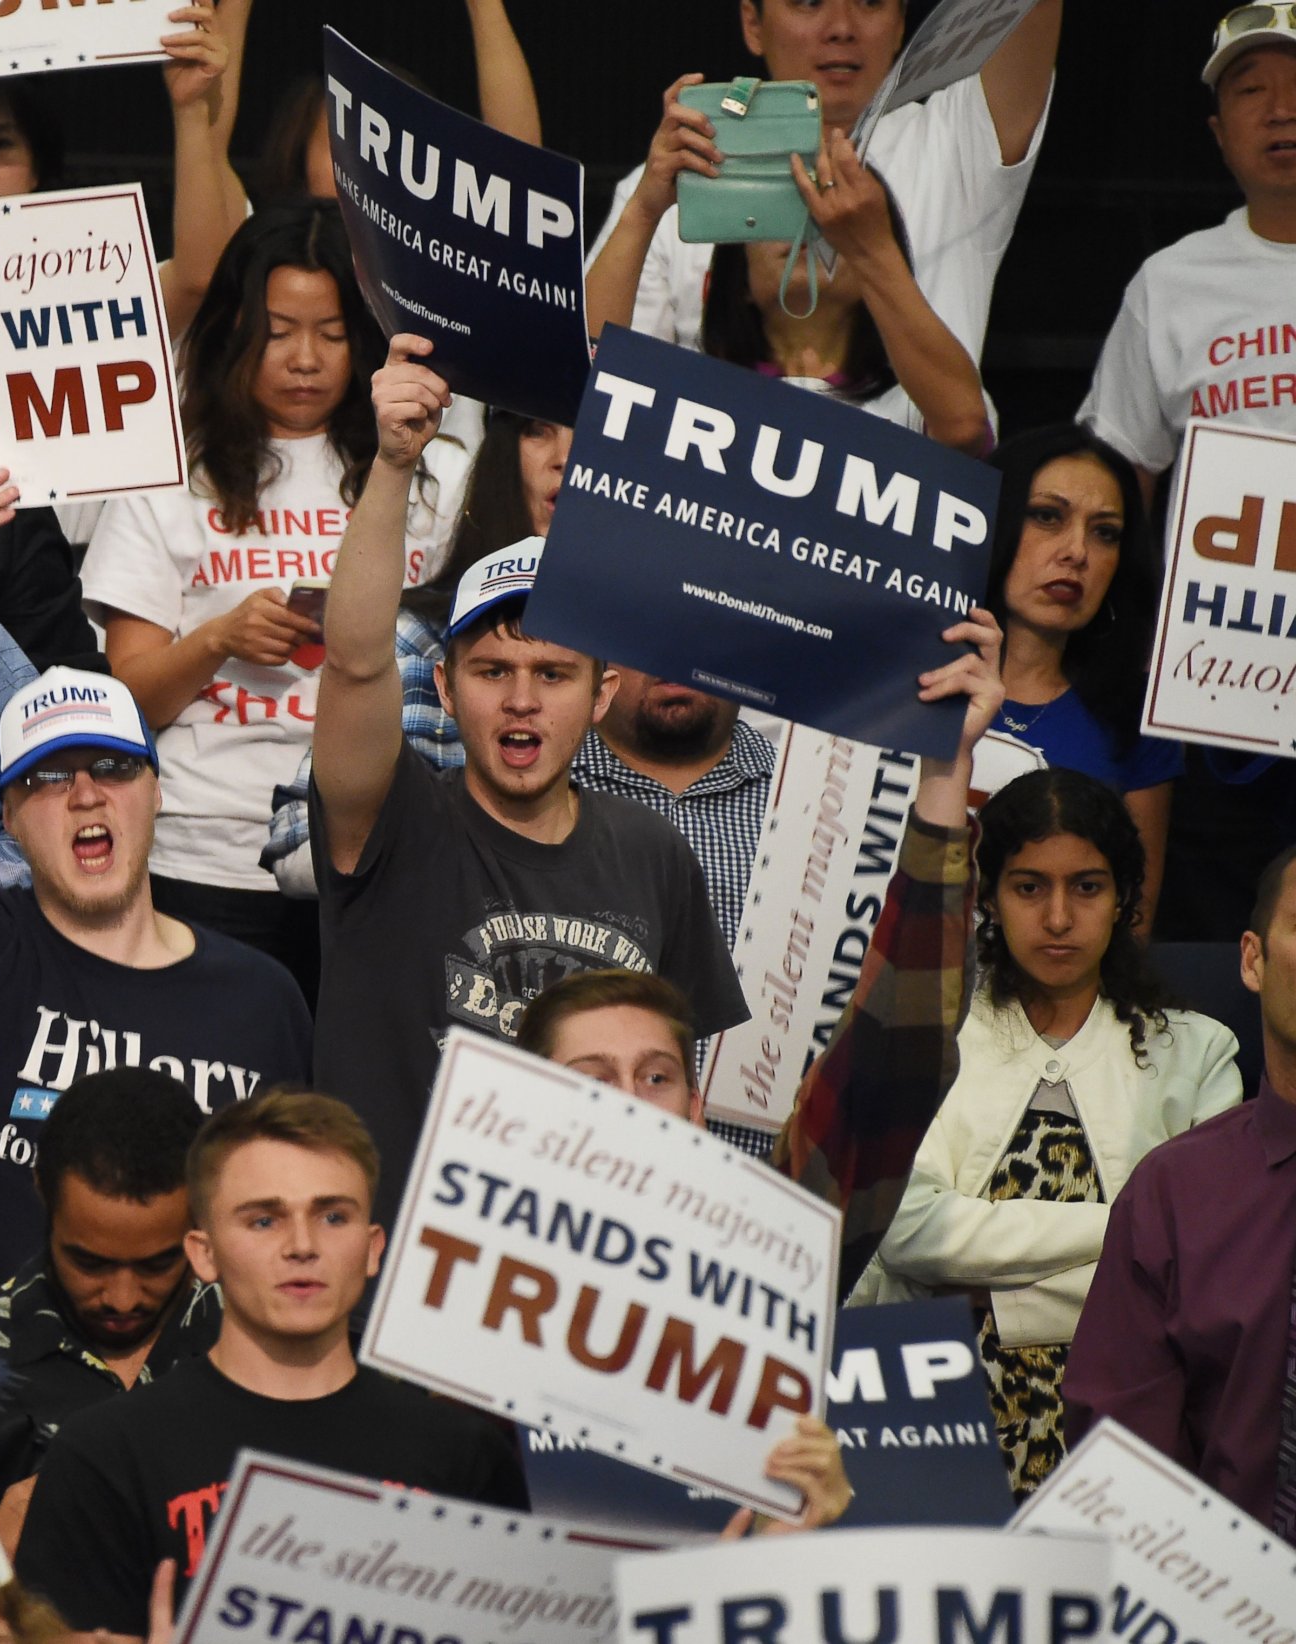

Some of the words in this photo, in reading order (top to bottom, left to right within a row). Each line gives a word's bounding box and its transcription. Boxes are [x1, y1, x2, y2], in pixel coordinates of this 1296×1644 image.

[327, 74, 575, 249] TRUMP
[335, 162, 360, 206] MAKE
[362, 193, 423, 254] AMERICA
[429, 239, 491, 282] GREAT
[497, 268, 577, 312] AGAIN!
[1, 296, 149, 350] WITH
[381, 279, 472, 336] www.DonaldJTrump.com
[594, 371, 989, 553] TRUMP
[485, 557, 536, 579] TRU
[569, 464, 649, 510] MAKE
[654, 492, 781, 554] AMERICA
[791, 537, 882, 584] GREAT
[683, 581, 833, 640] www.DonaldJTrump.com
[21, 686, 107, 719] TRUMP
[553, 917, 611, 954] WORK
[760, 903, 815, 1033] silent
[740, 1034, 782, 1111] the
[450, 1089, 525, 1145] the
[531, 1118, 656, 1196] silent
[666, 1177, 824, 1291] majority
[433, 1161, 672, 1281] STANDS
[688, 1247, 819, 1353] WITH
[418, 1225, 814, 1430] TRUMP
[880, 1421, 989, 1450] AGAIN!
[238, 1513, 323, 1568] the
[322, 1538, 456, 1603] silent
[1060, 1476, 1125, 1525] the
[1119, 1519, 1231, 1601] silent
[634, 1586, 1103, 1644] TRUMP
